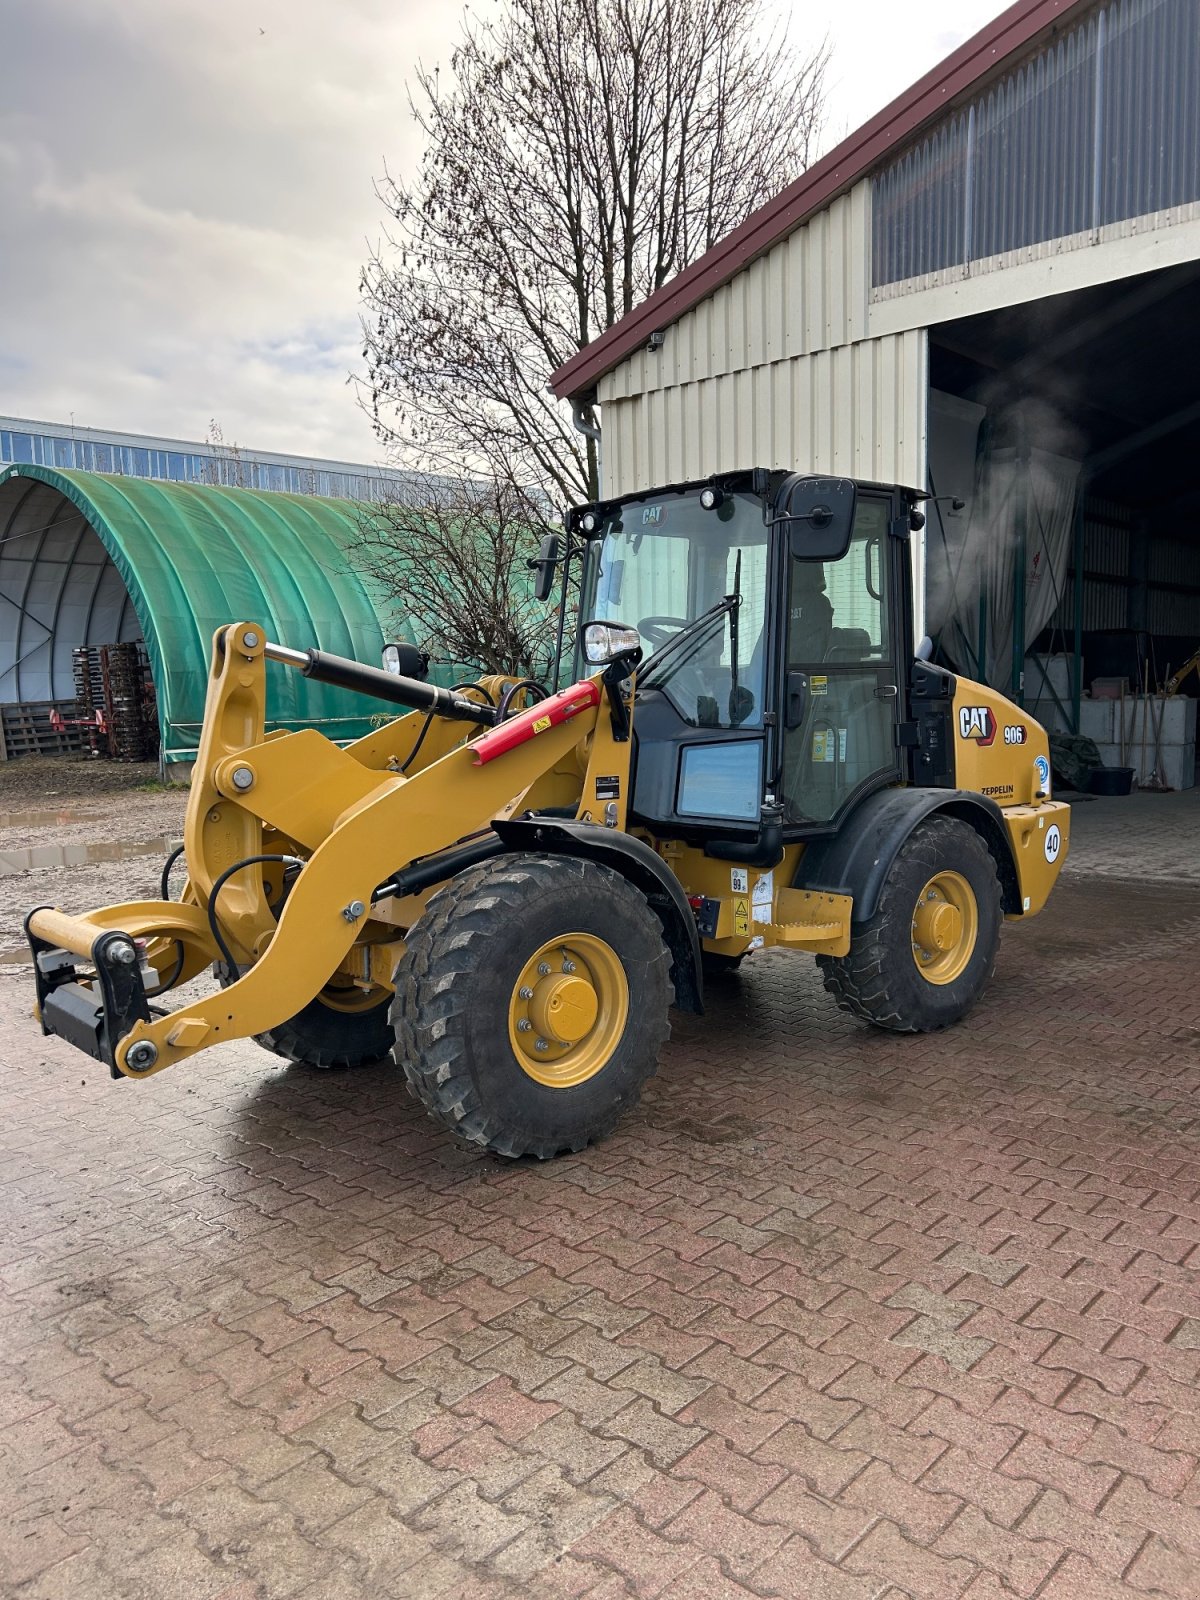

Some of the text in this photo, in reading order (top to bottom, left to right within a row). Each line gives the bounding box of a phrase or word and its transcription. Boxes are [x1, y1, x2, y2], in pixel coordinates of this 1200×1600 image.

[642, 506, 662, 525] CAT
[960, 707, 987, 738] CAT
[1004, 726, 1023, 744] 906
[981, 784, 1014, 796] ZEPPELIN
[1046, 834, 1059, 853] 40
